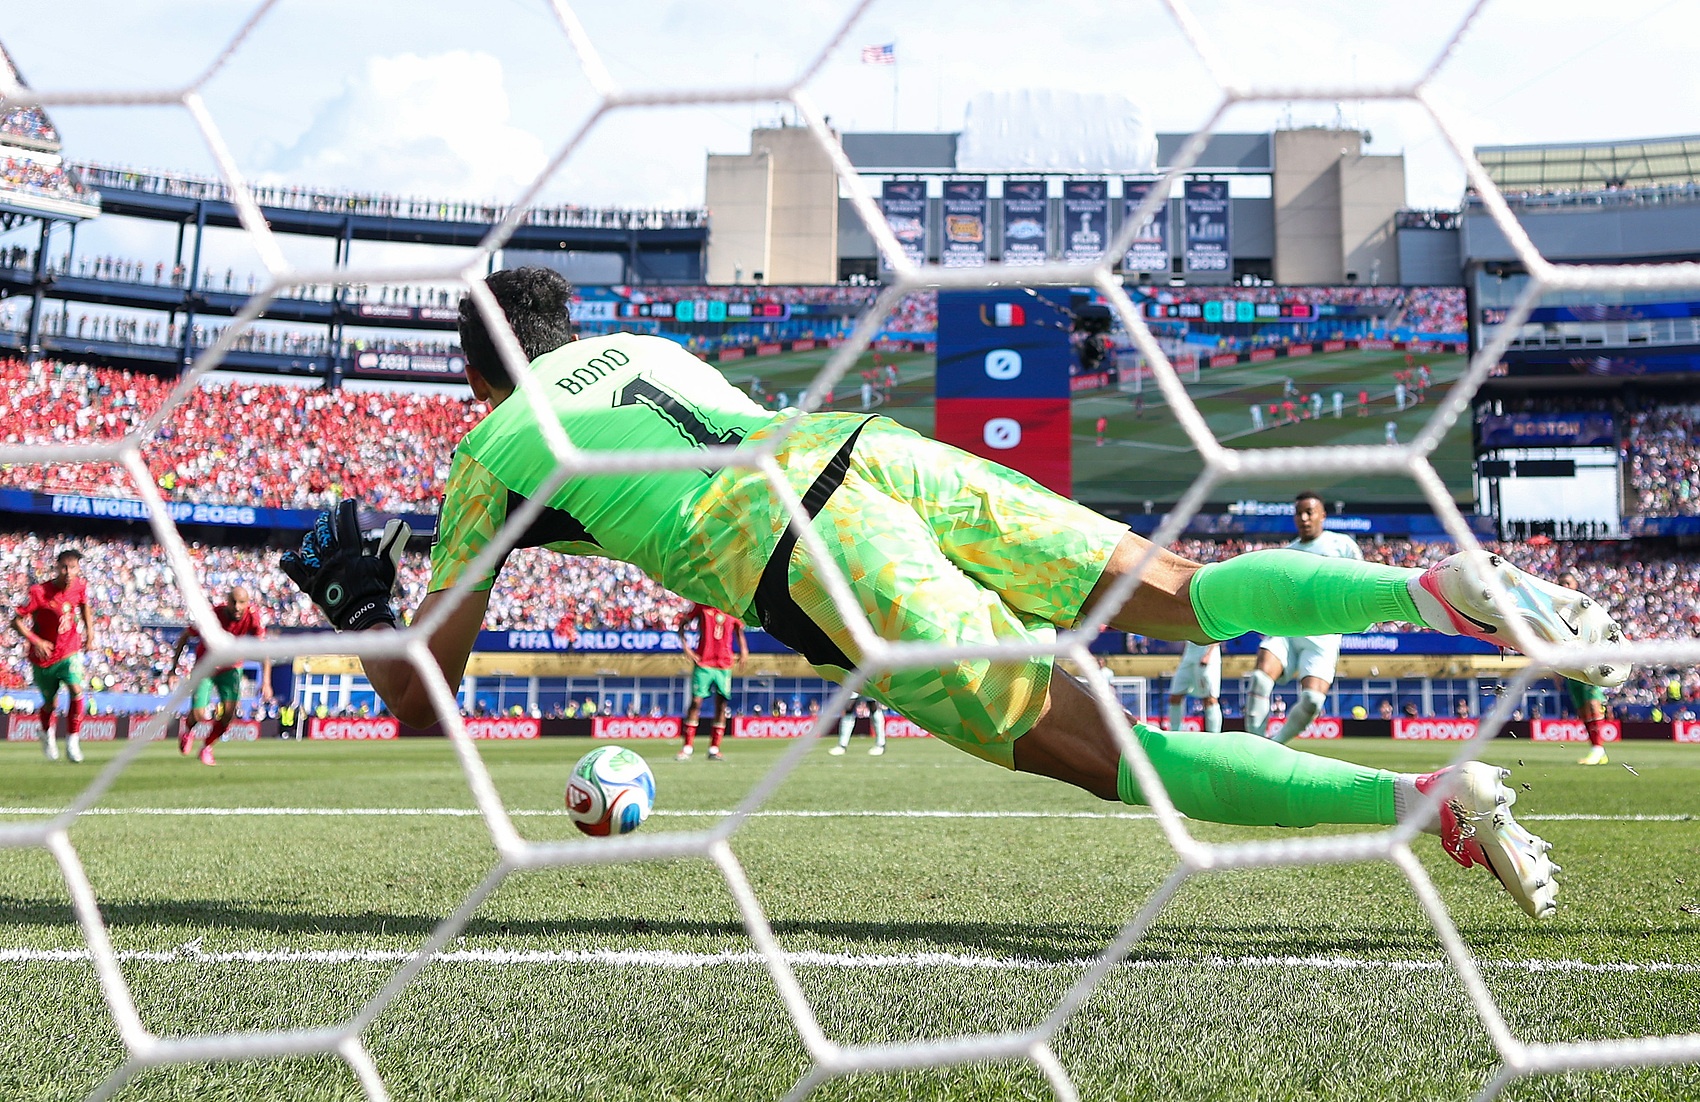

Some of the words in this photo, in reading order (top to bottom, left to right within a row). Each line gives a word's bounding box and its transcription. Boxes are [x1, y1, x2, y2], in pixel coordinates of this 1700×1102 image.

[555, 348, 630, 395] BONO
[611, 370, 748, 478] 1
[1513, 421, 1581, 436] BOSTON
[52, 495, 91, 515] FIFA
[169, 502, 193, 521] UP
[193, 506, 256, 525] 2026
[348, 602, 376, 625] BONO
[507, 631, 551, 650] FIFA
[620, 632, 660, 650] CUP
[312, 719, 397, 739] Lenovo
[466, 721, 539, 739] enovo
[594, 718, 679, 738] Lenovo
[1393, 718, 1477, 739] Lenovo
[1534, 719, 1617, 740] Lenoo
